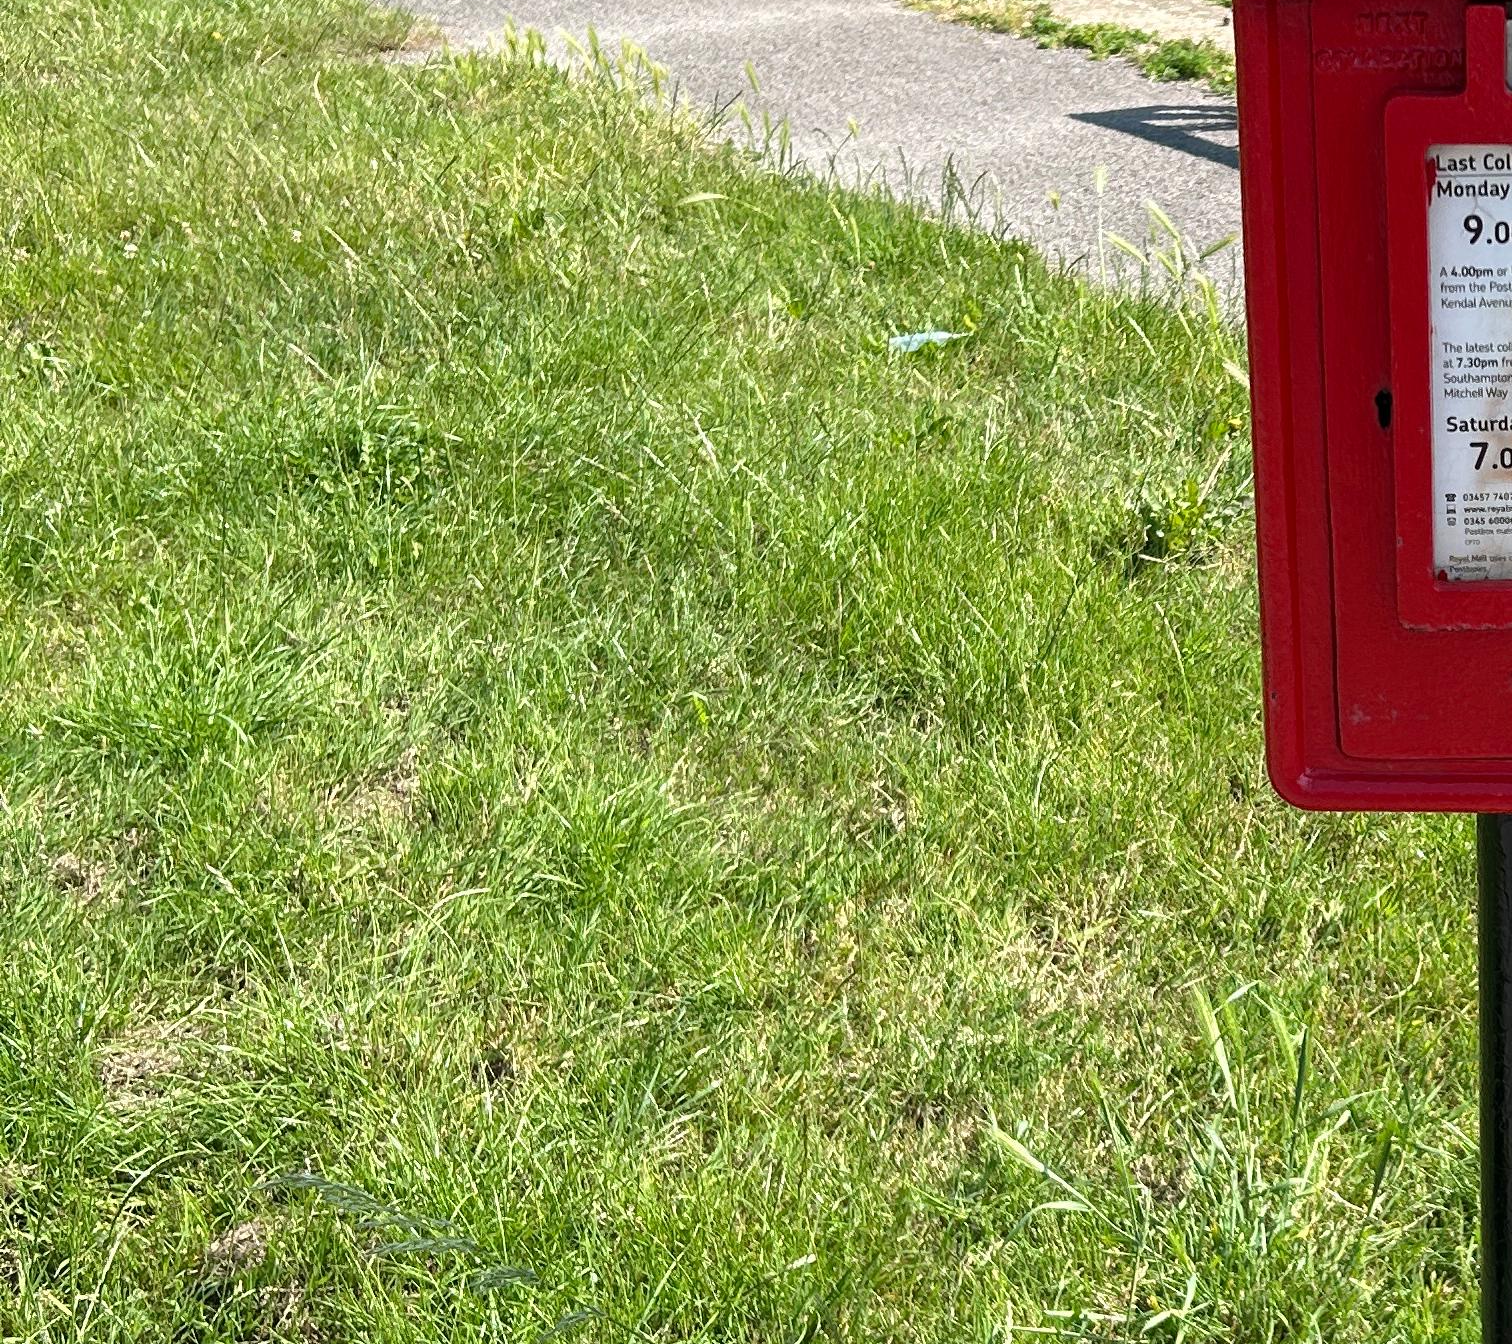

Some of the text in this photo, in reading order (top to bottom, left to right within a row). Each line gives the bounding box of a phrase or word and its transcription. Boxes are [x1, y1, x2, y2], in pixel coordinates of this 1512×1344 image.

[1436, 153, 1477, 172] Last
[1436, 179, 1510, 200] Monday
[1440, 267, 1448, 278] A
[1450, 265, 1494, 280] 4.00pm
[1496, 267, 1508, 277] or
[1440, 281, 1466, 294] from
[1469, 281, 1487, 293] the
[1441, 297, 1477, 309] Kendal
[1442, 342, 1463, 354] The
[1465, 341, 1494, 354] latest
[1442, 358, 1454, 369] at
[1456, 358, 1499, 371] 7.30pm
[1443, 387, 1509, 401] Mitchell Way
[1462, 492, 1490, 502] 03457
[1463, 517, 1486, 526] 0345
